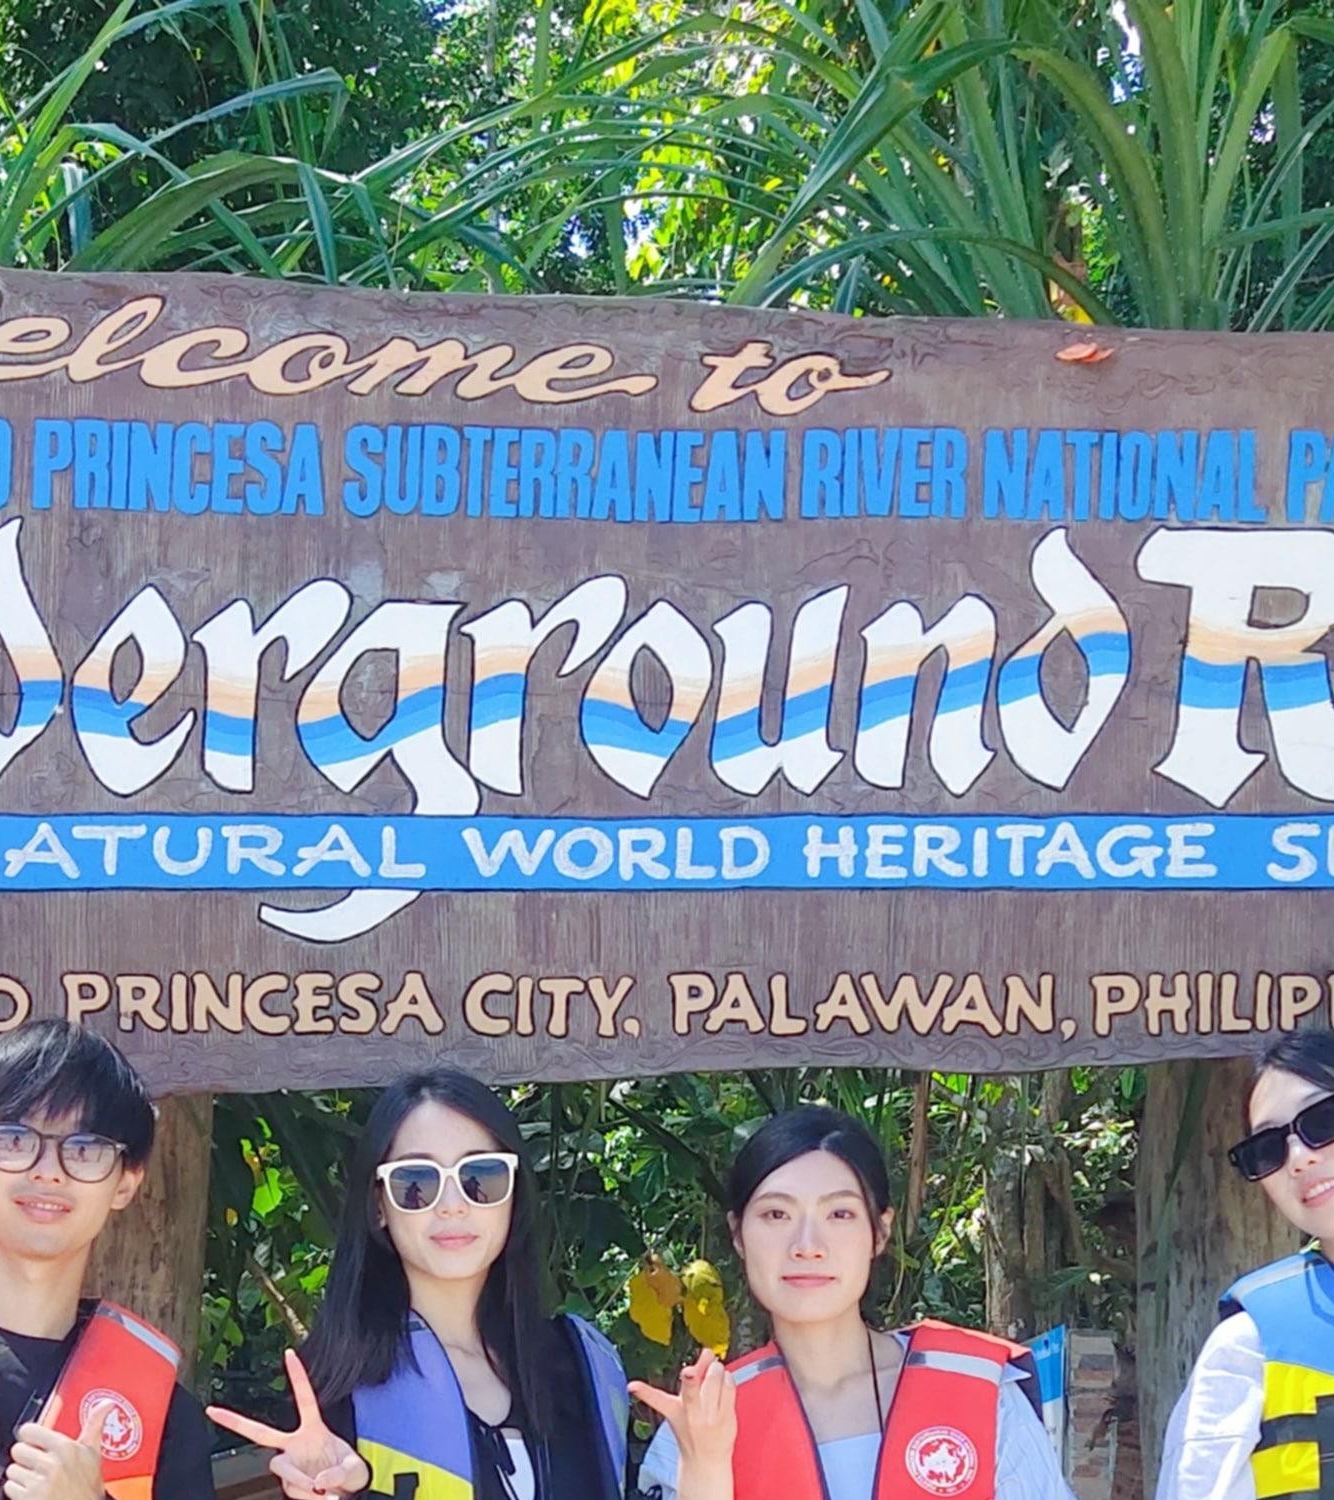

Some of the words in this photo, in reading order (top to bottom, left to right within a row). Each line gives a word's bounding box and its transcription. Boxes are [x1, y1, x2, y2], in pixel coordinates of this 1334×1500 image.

[690, 339, 892, 416] to
[31, 419, 326, 516] PRINCESA
[342, 424, 789, 523] SUBTERRANEAN
[801, 427, 969, 521] RIVER
[982, 427, 1267, 524] NATIONAL
[463, 822, 770, 882] WORLD
[803, 820, 1218, 881] HERITAGE
[61, 970, 444, 1038] PRINCESA
